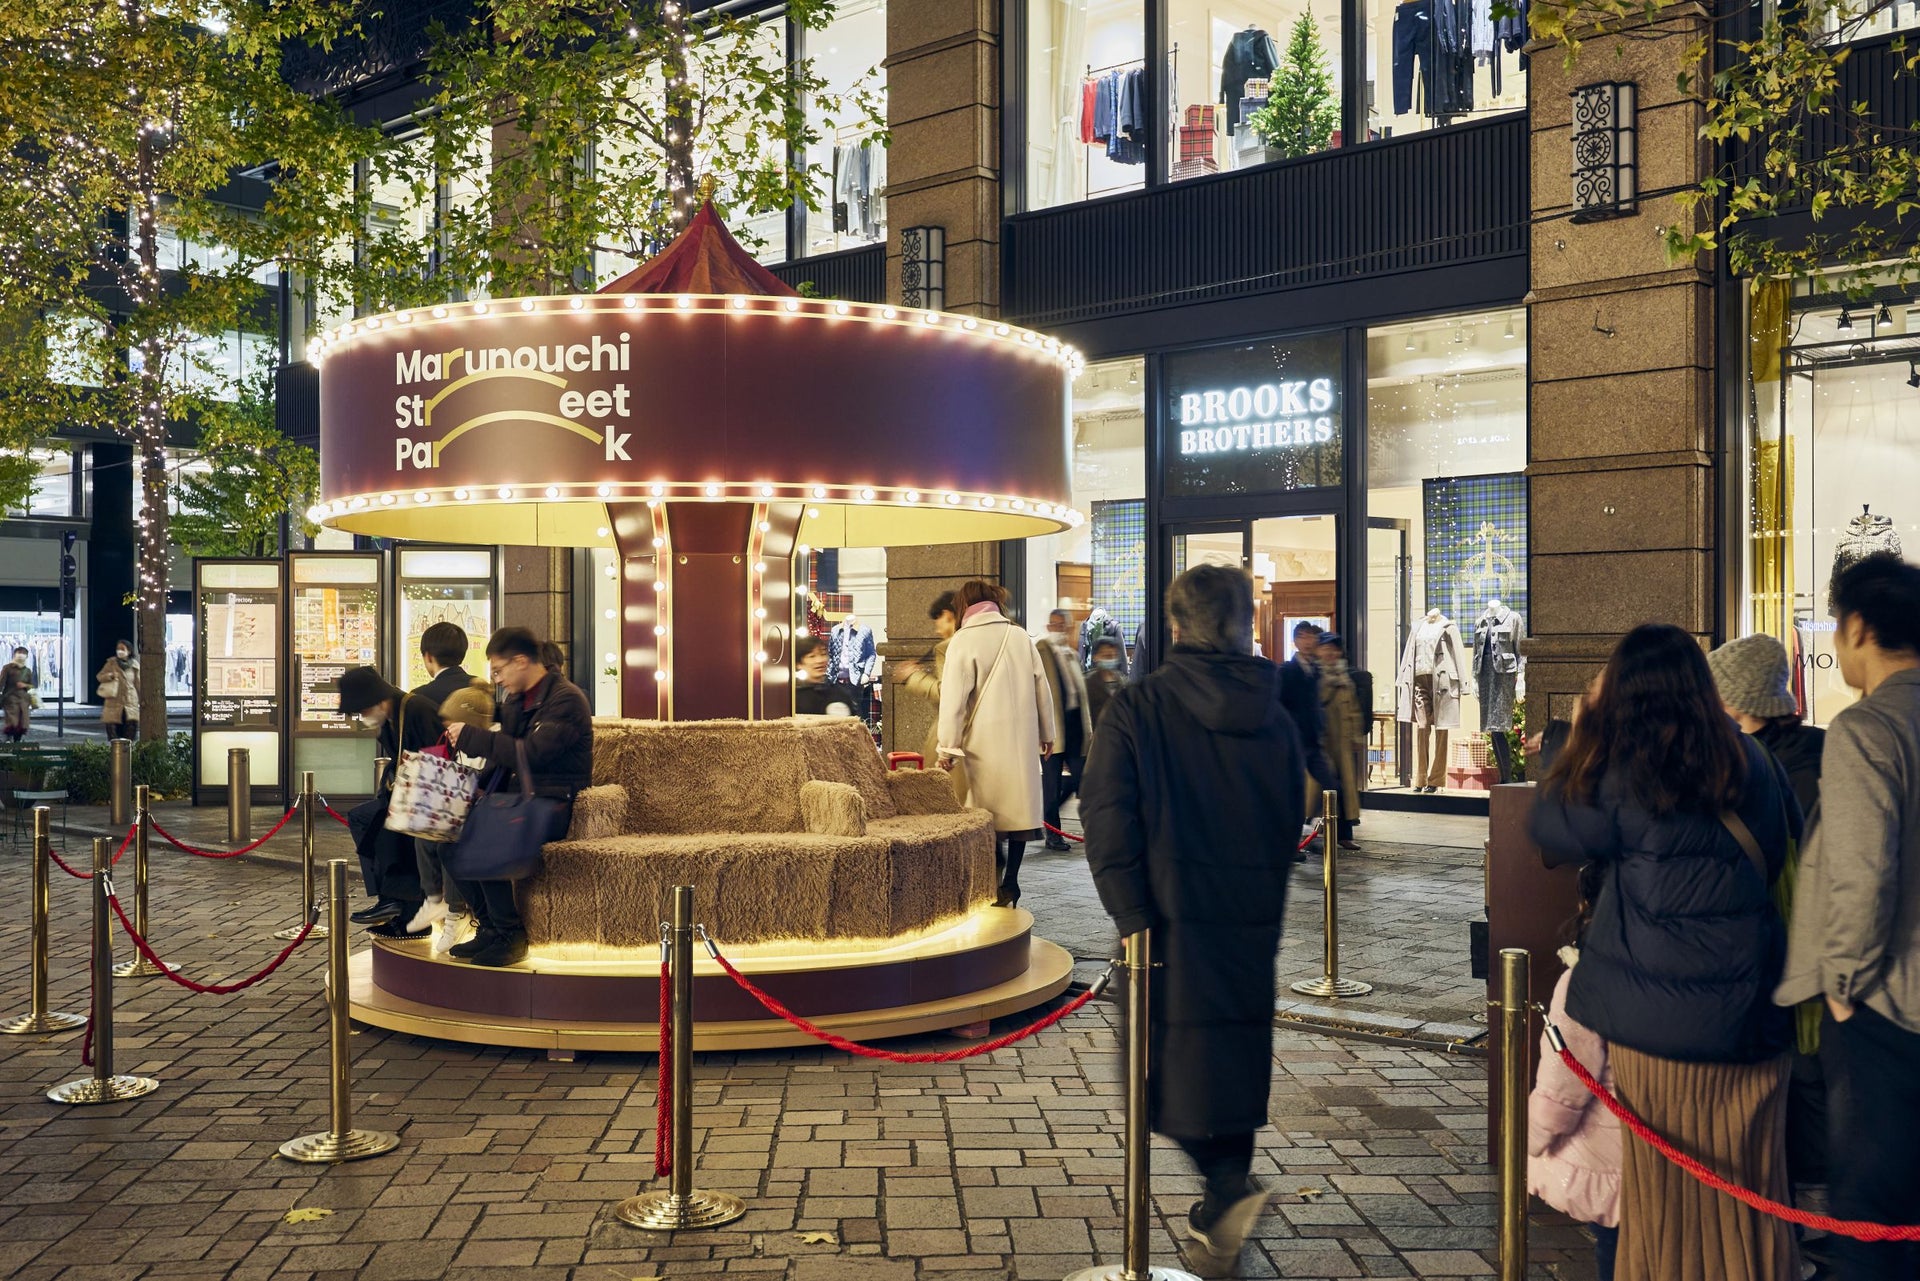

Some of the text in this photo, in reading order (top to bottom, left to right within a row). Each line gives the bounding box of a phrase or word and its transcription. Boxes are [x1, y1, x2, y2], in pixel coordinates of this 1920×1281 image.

[396, 332, 630, 385] Marunouchi
[1180, 378, 1333, 426] BROOKS
[1180, 417, 1332, 455] BROTHERS
